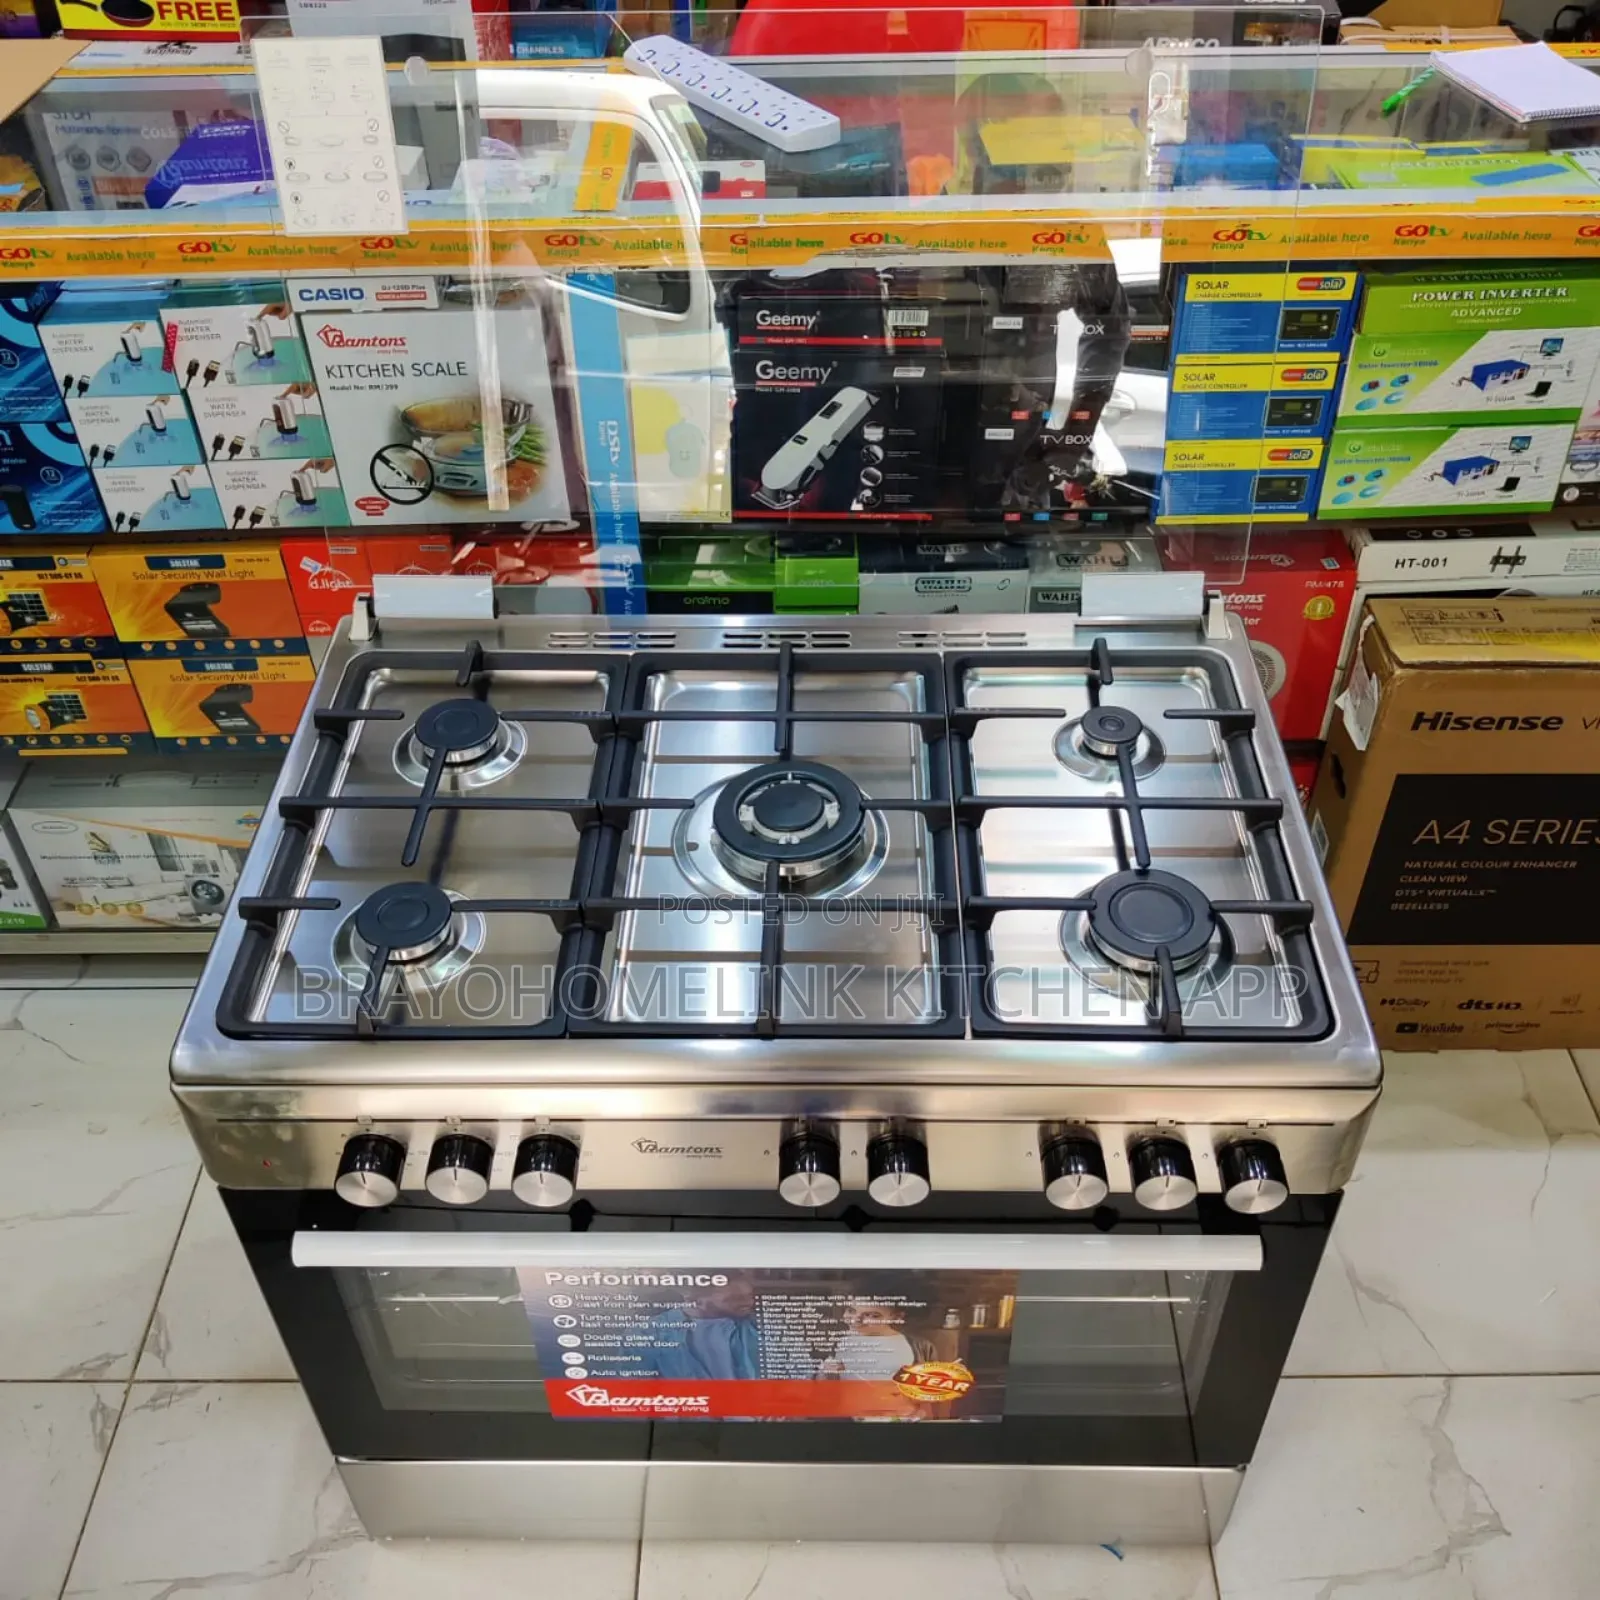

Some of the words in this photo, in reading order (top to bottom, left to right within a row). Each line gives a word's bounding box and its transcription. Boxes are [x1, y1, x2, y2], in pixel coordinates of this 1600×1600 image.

[156, 1, 236, 21] FREE
[1213, 228, 1271, 241] GOtv
[1395, 225, 1453, 237] GOtv
[1462, 231, 1519, 241] Available
[1524, 231, 1551, 240] here
[360, 236, 420, 249] GOtv
[544, 234, 602, 246] GOtv
[796, 238, 824, 247] here
[849, 232, 905, 245] GOtv
[1032, 231, 1090, 244] GOtv
[1280, 233, 1337, 244] Available
[1341, 233, 1369, 242] here
[1394, 238, 1425, 247] Kenya
[177, 240, 236, 254] GOtv
[613, 239, 673, 250] Available
[917, 238, 975, 249] Available
[979, 239, 1007, 248] here
[1212, 242, 1244, 251] Kenya
[248, 246, 304, 256] Available
[308, 244, 339, 255] here
[546, 249, 580, 257] Kenya
[67, 252, 123, 262] Available
[127, 251, 155, 260] here
[182, 255, 215, 264] Kenya
[1196, 281, 1230, 290] SOLAR
[298, 288, 364, 301] CASIO
[1413, 290, 1475, 301] POWER
[1480, 287, 1569, 300] INVERTER
[1450, 307, 1522, 318] ADVANCED
[756, 310, 817, 330] Geemy
[184, 325, 210, 333] WATER
[178, 334, 221, 342] DISPENSER
[325, 327, 407, 348] Ramtons
[325, 363, 405, 379] KITCHEN
[411, 361, 468, 377] SCALE
[756, 360, 831, 384] Geemy
[1183, 373, 1216, 381] SOLAR
[203, 410, 246, 419] DISPENSER
[1040, 435, 1065, 445] TV
[1065, 435, 1093, 445] BOX
[1173, 453, 1205, 461] SOLAR
[224, 482, 266, 491] DISPENSER
[169, 559, 200, 567] SOLSTAR
[1394, 558, 1447, 568] HT-001
[133, 571, 159, 580] Solar
[161, 571, 200, 580] Security
[204, 570, 226, 578] Wall
[229, 569, 255, 579] Light
[310, 579, 351, 591] d.light
[21, 663, 54, 671] SOLSTAR
[205, 662, 234, 670] SOLSTAR
[170, 674, 194, 682] Solar
[196, 673, 235, 682] Security
[238, 672, 258, 680] Wall
[261, 672, 285, 680] Light
[1411, 711, 1564, 731] Hisense
[1412, 819, 1471, 845] A4
[1460, 860, 1509, 868] COLOUR
[1512, 860, 1577, 868] ENHANCER
[1400, 875, 1436, 883] CLEAN
[1439, 875, 1468, 883] VIEW
[1391, 902, 1449, 910] BEZELLESS
[1419, 1024, 1464, 1034] YouTube
[638, 1140, 724, 1153] Ramtons
[545, 1272, 729, 1287] Performance
[604, 1321, 648, 1329] cooking
[915, 1375, 970, 1391] YEAR
[574, 1387, 710, 1406] Ramtons
